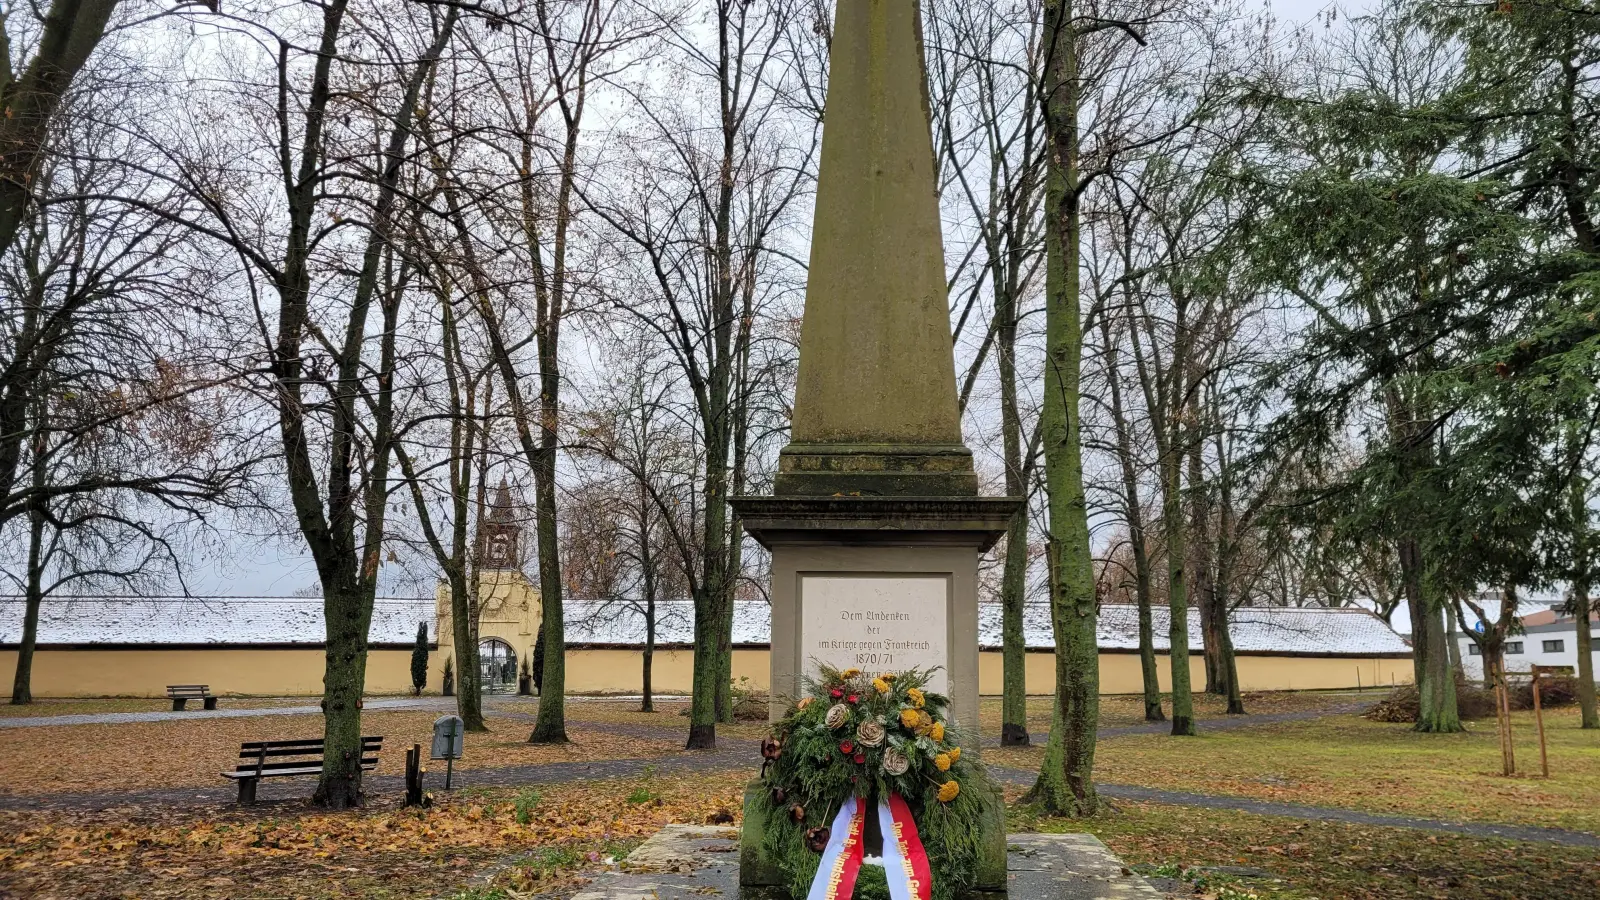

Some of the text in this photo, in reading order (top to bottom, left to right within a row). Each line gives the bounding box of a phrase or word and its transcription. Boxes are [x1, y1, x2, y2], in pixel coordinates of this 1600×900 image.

[840, 610, 910, 620] Dem Andenken
[867, 625, 881, 635] der
[818, 638, 930, 651] im Kriege gegen Frankreich
[855, 653, 893, 665] 1870/71
[890, 821, 903, 839] Den
[901, 858, 915, 878] zum
